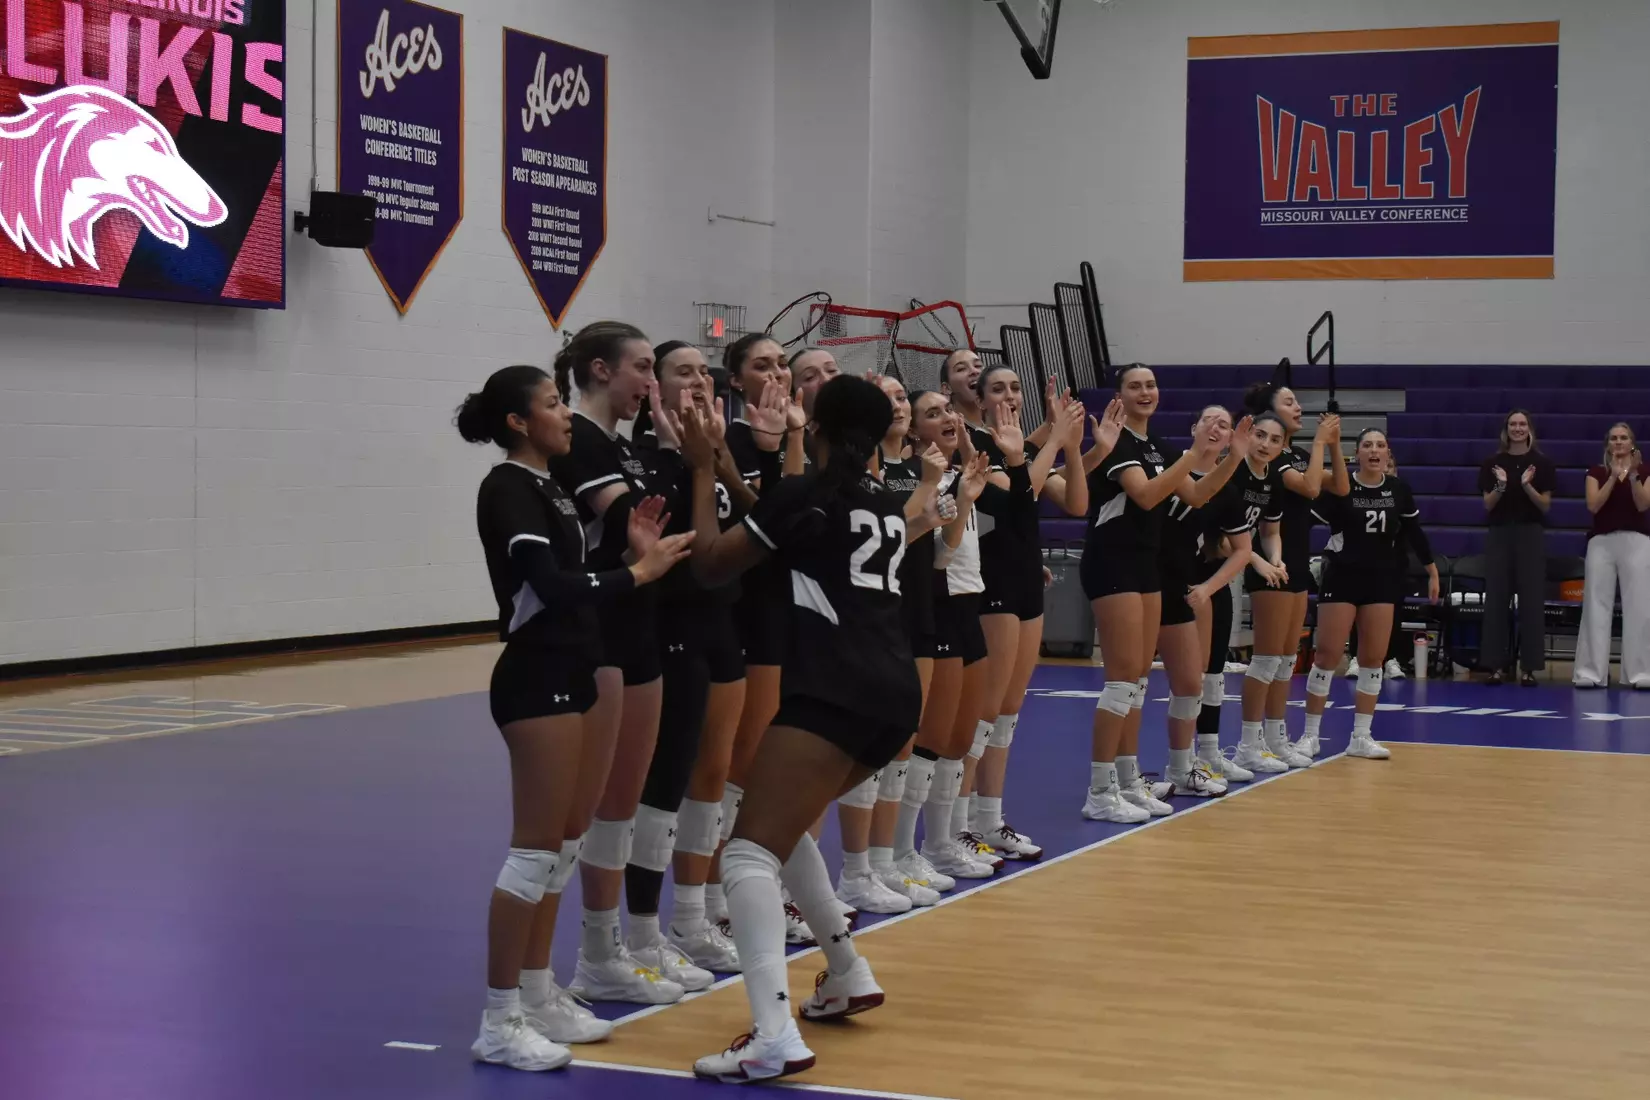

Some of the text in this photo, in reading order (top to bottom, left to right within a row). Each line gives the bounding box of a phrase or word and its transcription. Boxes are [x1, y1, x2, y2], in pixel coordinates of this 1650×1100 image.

[0, 0, 282, 134] LUKIS
[1330, 93, 1398, 118] THE
[360, 114, 442, 145] WOMEN'S BASKETBALL
[365, 138, 437, 166] CONFERENCE TITLES
[1256, 85, 1482, 202] VALLEY
[521, 146, 589, 174] WOMEN'S BASKETBALL
[403, 180, 434, 196] Tournament
[512, 166, 597, 196] POST SEASON APPEARANCES
[385, 193, 399, 205] MVC
[400, 196, 419, 209] Regular
[420, 198, 439, 212] Season
[403, 211, 434, 226] Tournament
[554, 206, 565, 218] First
[565, 208, 580, 220] Round
[1261, 207, 1468, 223] MISSOURI VALLEY CONFERENCE
[554, 220, 565, 231] First
[565, 222, 580, 234] Round
[569, 237, 583, 248] Round
[554, 248, 565, 260] First
[565, 250, 580, 262] Round
[564, 264, 578, 275] Round
[1353, 497, 1395, 508] SALUKIS
[1245, 505, 1261, 527] 18
[1365, 510, 1386, 533] 21
[850, 508, 906, 597] 22
